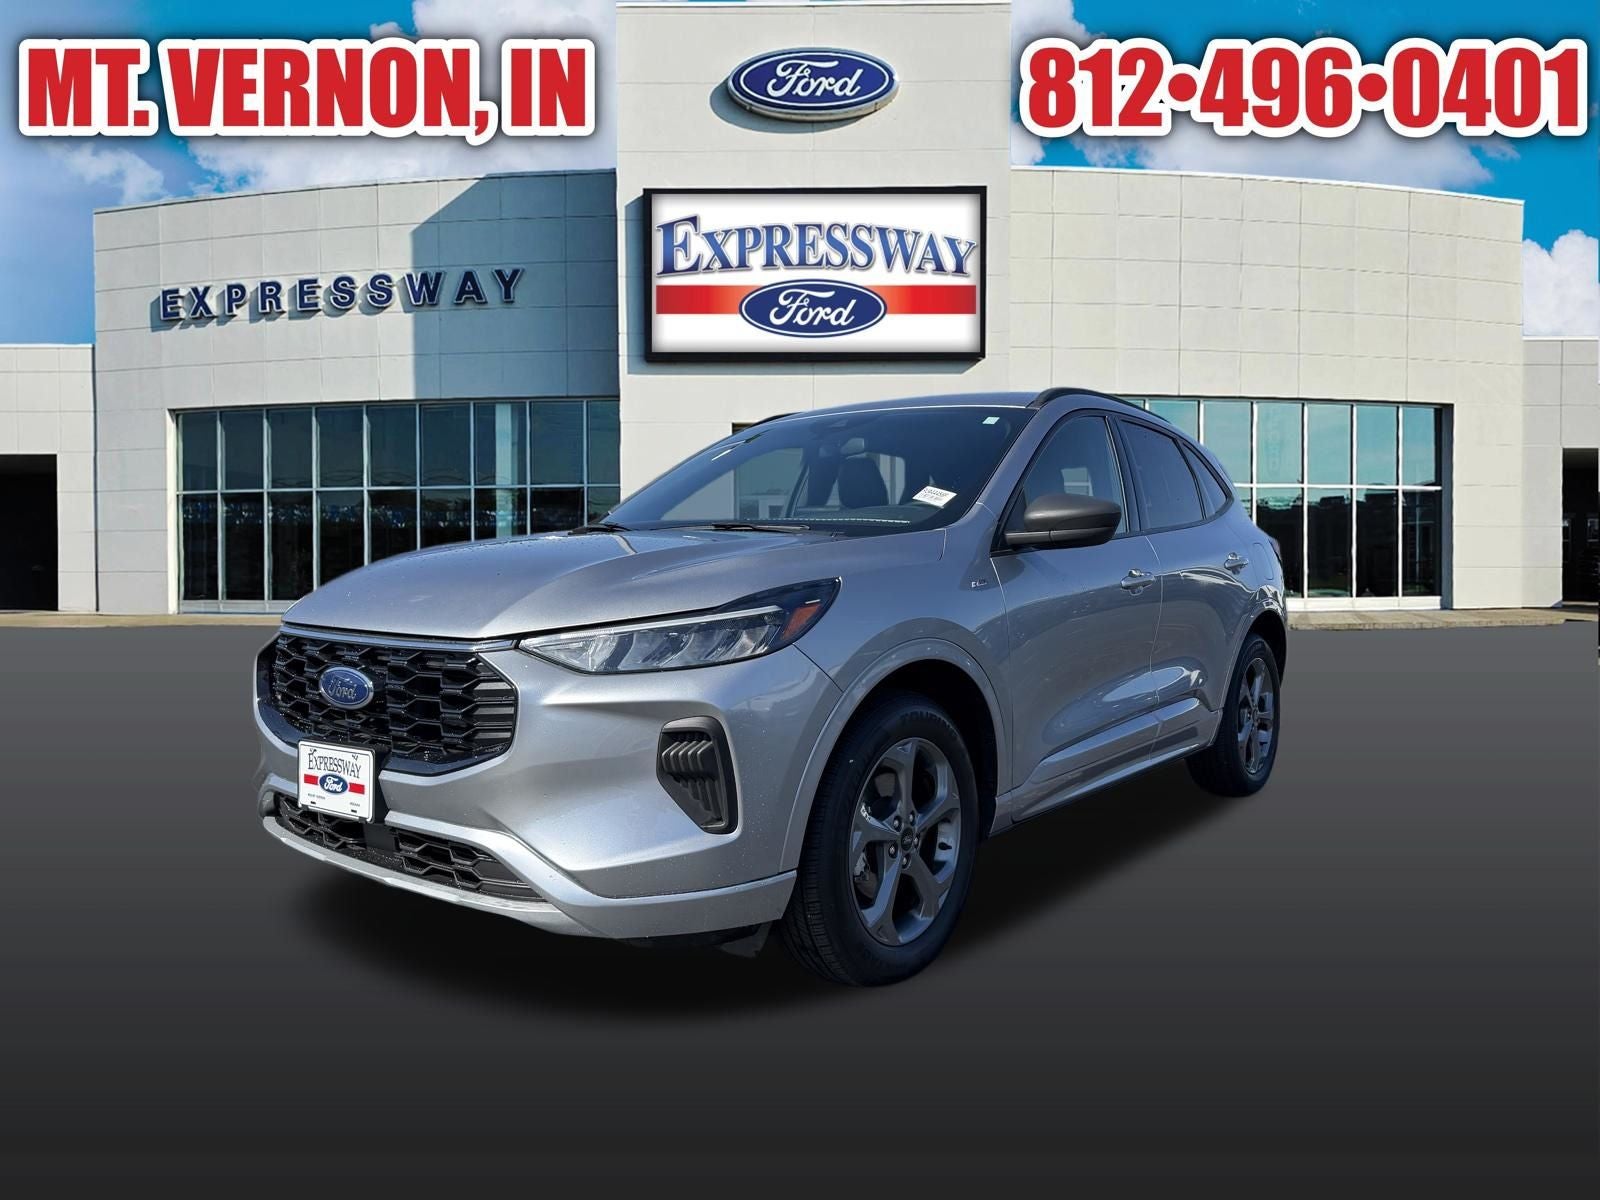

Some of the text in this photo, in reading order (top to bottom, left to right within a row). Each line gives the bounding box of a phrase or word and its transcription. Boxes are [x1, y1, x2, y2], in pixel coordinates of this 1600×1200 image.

[766, 59, 864, 98] Ford
[656, 214, 977, 278] EXPRESSWAY
[159, 267, 525, 322] EXPRESSWAY
[769, 288, 856, 327] Ford
[328, 676, 357, 701] Ford
[307, 752, 362, 779] EXPRESSWAY
[323, 776, 343, 793] Ford
